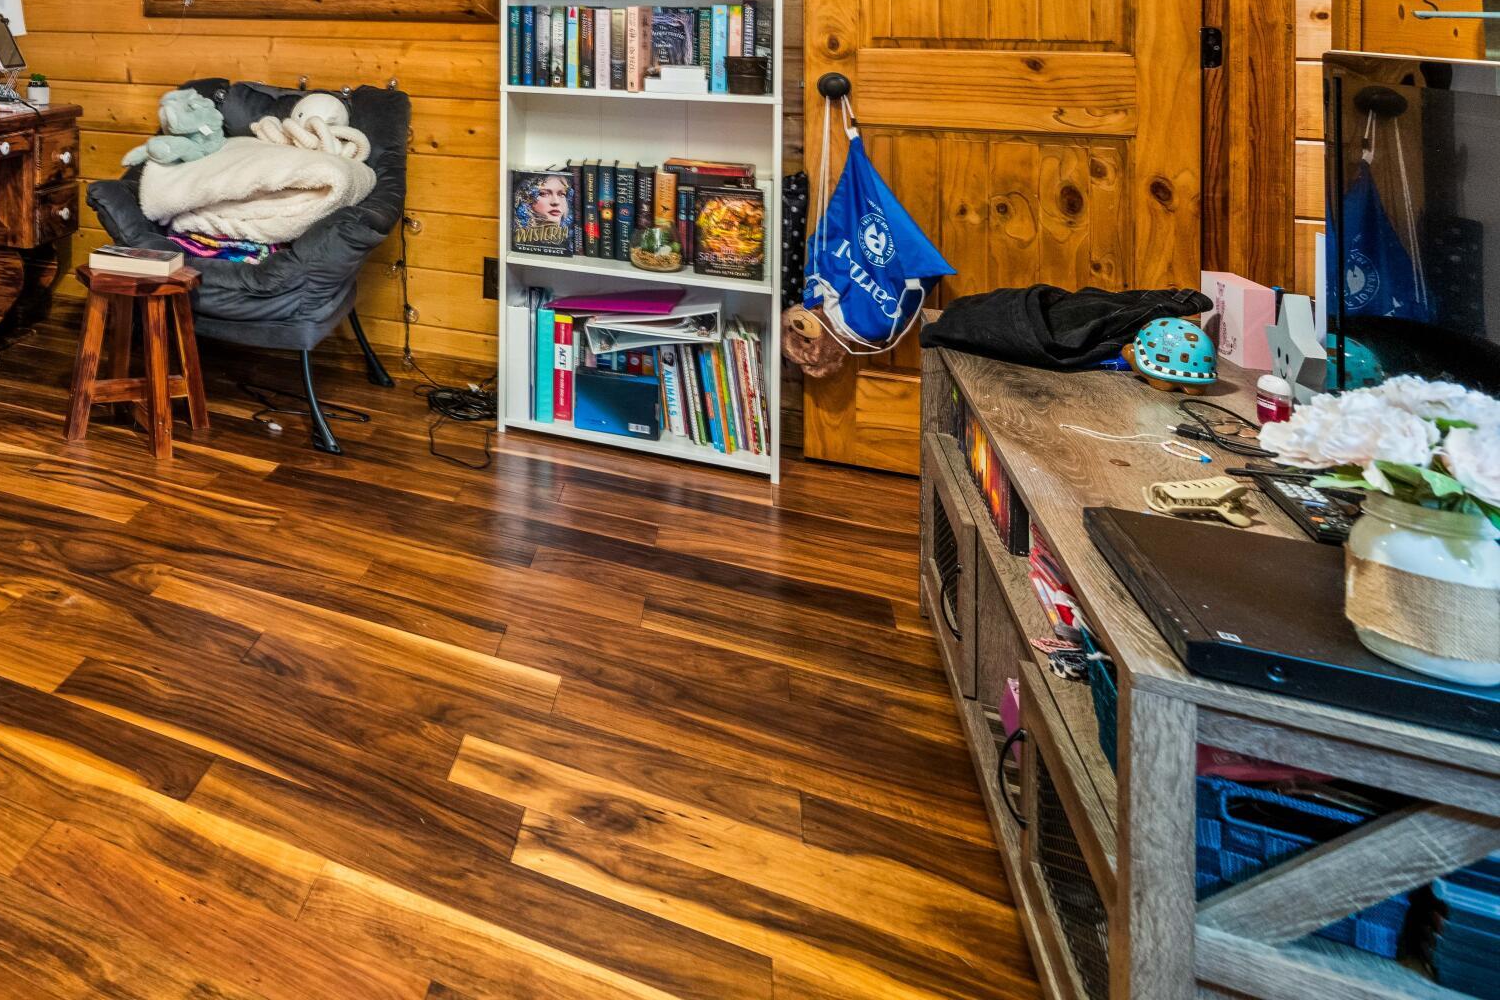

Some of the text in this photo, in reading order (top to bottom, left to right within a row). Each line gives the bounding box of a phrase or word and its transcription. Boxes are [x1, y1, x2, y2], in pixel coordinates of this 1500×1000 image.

[617, 174, 628, 204] KING
[515, 224, 569, 243] WISTERIA
[558, 344, 567, 366] ACT
[663, 369, 677, 416] ANIMALS
